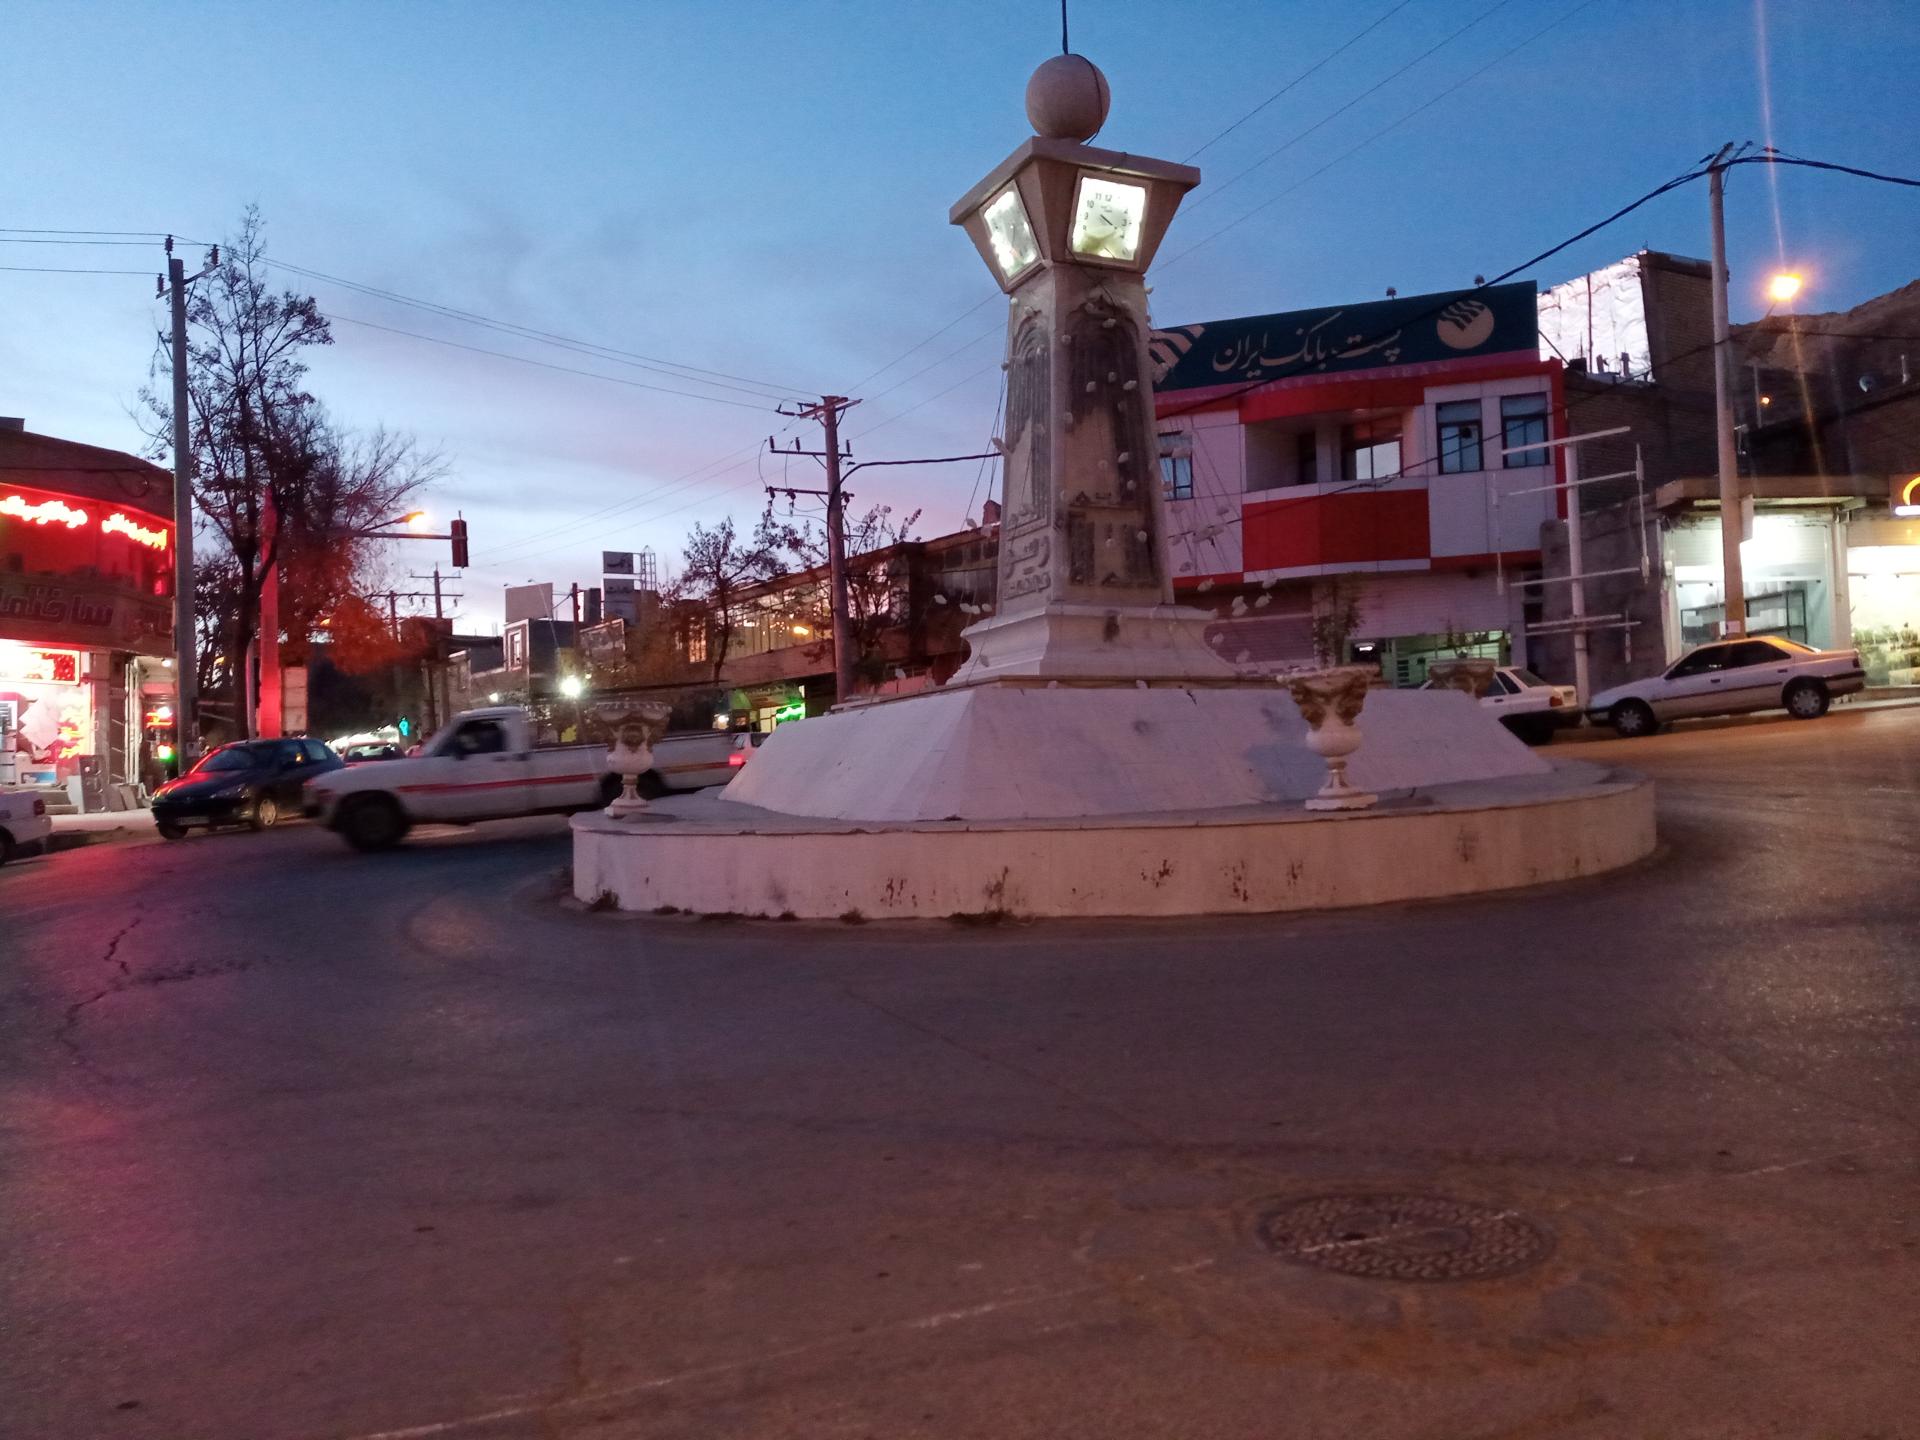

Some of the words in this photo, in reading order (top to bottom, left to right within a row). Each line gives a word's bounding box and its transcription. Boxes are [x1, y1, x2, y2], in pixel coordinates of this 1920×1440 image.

[1086, 199, 1095, 208] 10
[1212, 331, 1268, 378] ایران
[1259, 310, 1344, 371] بانک
[1331, 328, 1402, 363] پست
